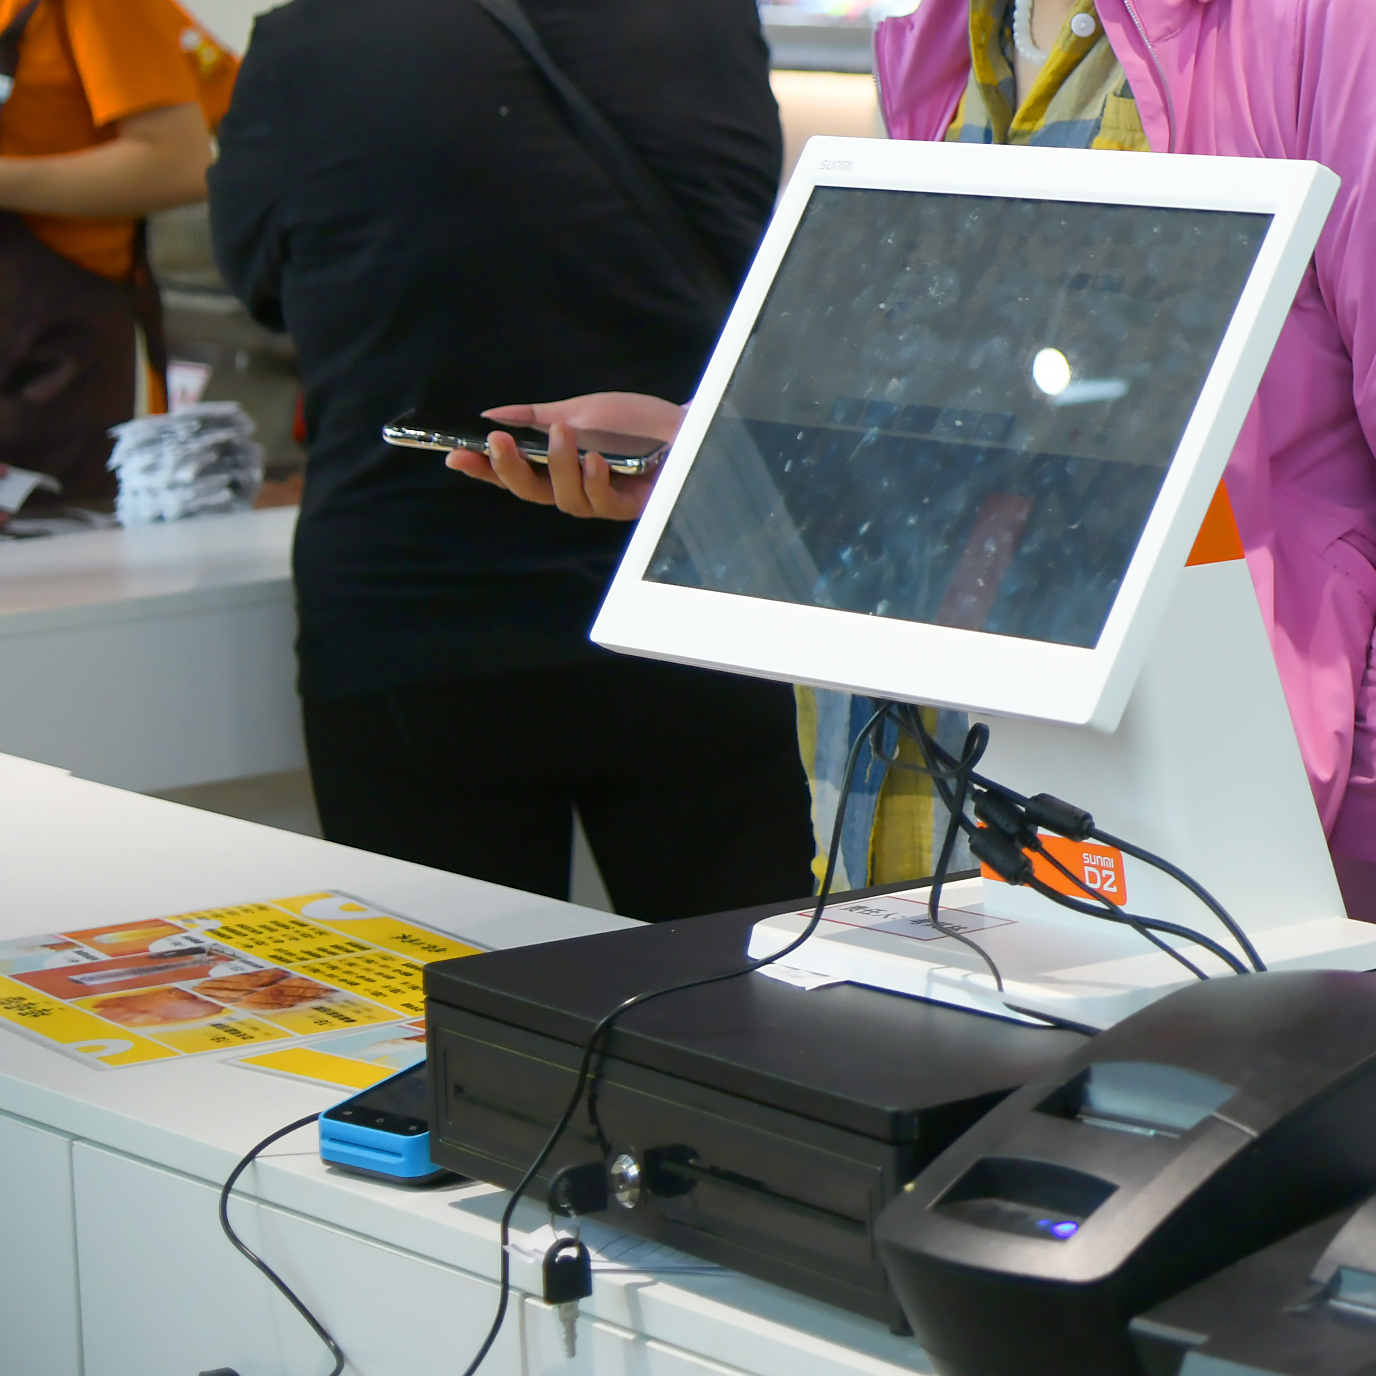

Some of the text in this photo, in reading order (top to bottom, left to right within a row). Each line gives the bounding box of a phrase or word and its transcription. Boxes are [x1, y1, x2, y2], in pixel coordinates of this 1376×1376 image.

[819, 160, 853, 171] SUNMI
[1083, 853, 1115, 868] SUNMI
[1084, 866, 1118, 893] D2
